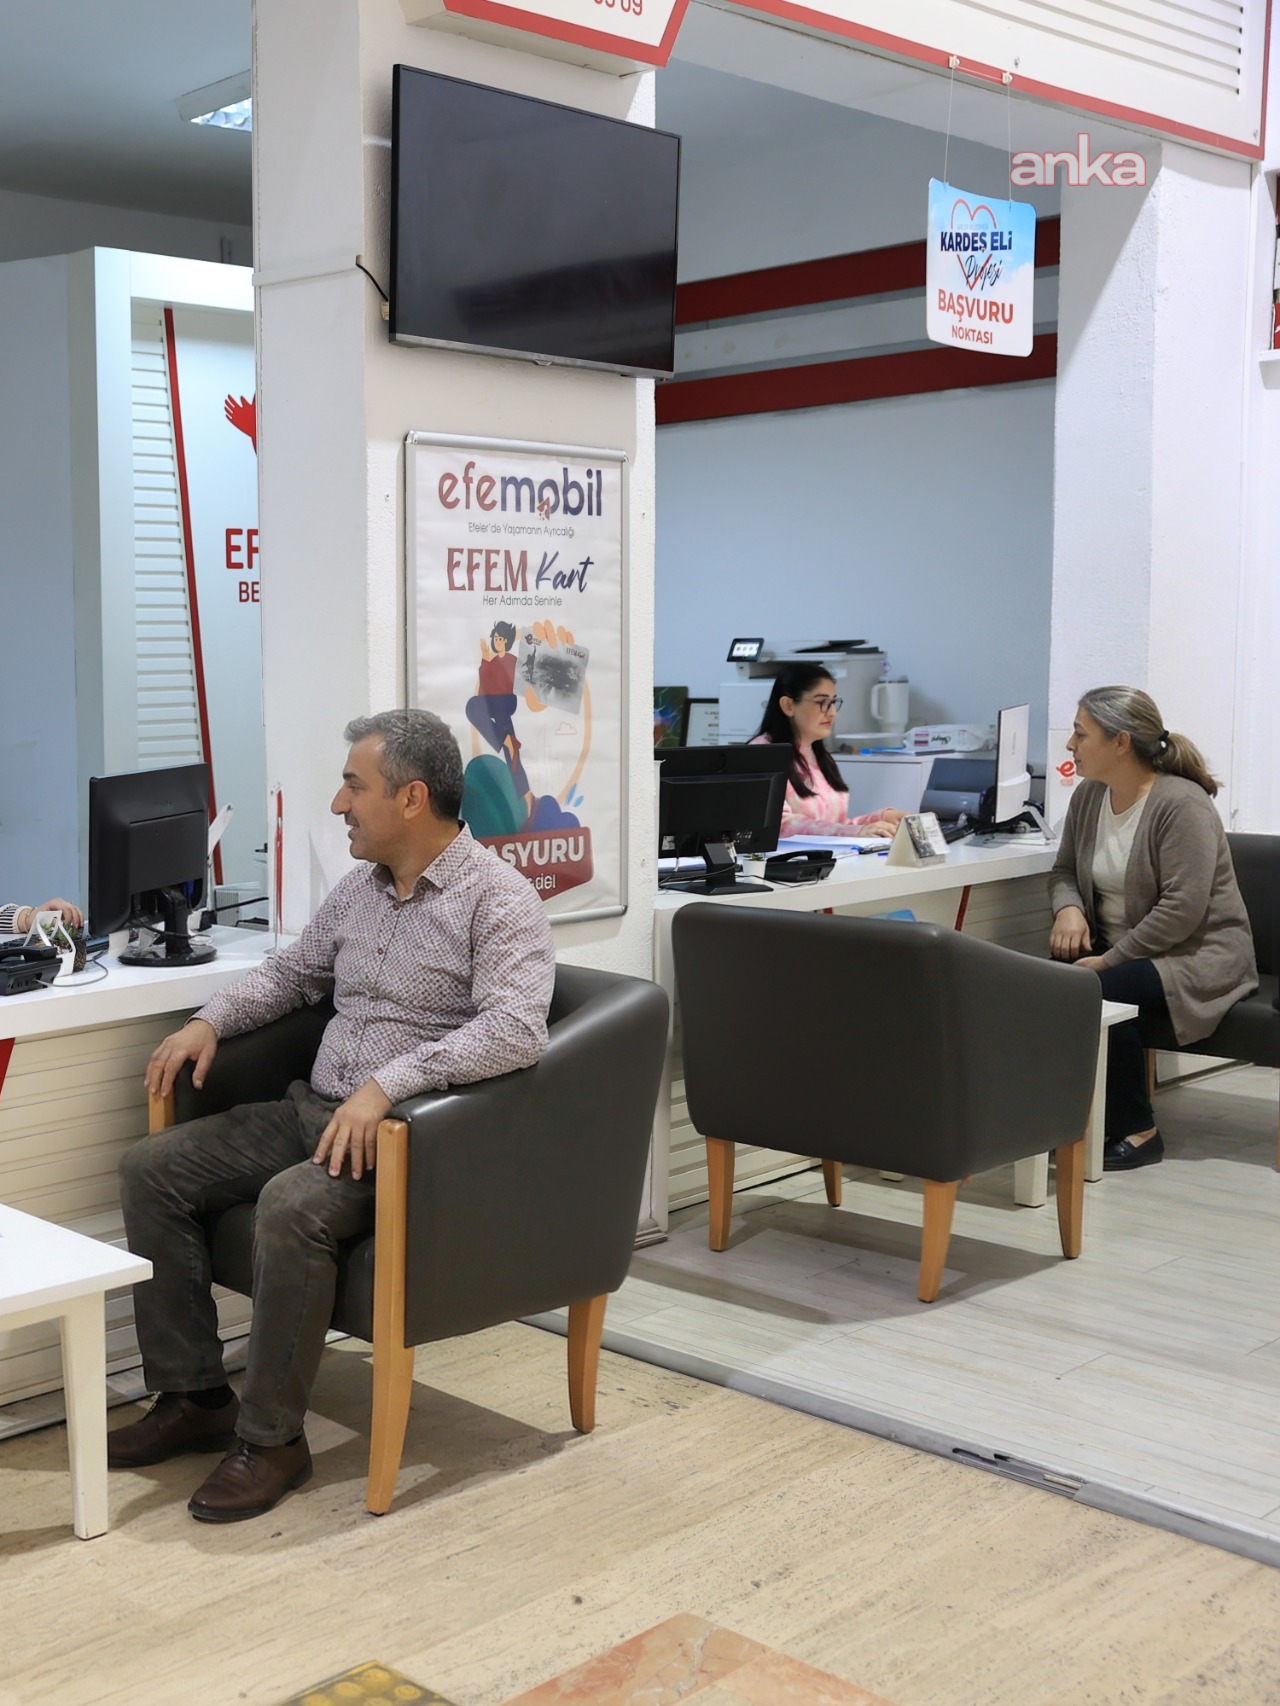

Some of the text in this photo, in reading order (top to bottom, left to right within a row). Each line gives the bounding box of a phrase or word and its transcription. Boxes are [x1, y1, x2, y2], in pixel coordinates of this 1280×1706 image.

[940, 231, 988, 253] KARDEŞ
[938, 288, 1014, 325] BAŞVURU
[951, 324, 993, 345] NOKTASI
[438, 460, 603, 517] efemobil
[446, 547, 595, 593] EFEM Kart
[483, 595, 497, 606] Her
[500, 595, 532, 607] Adımda
